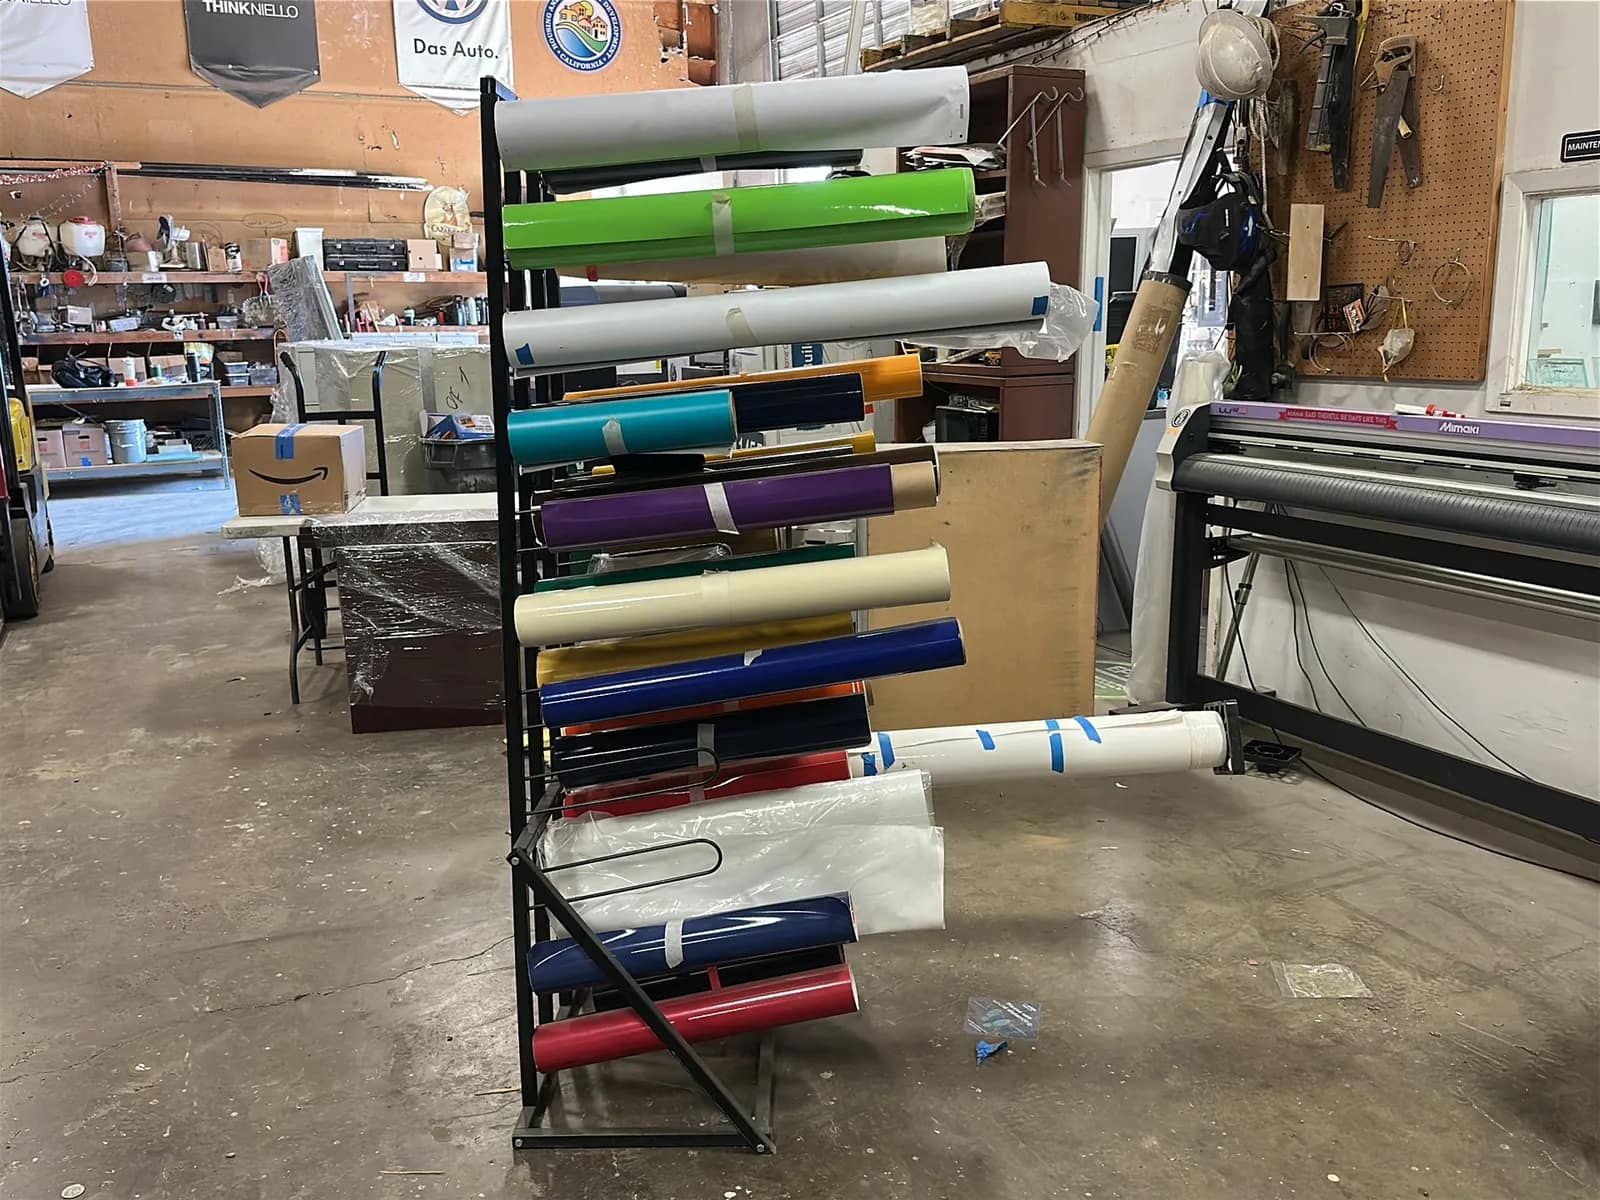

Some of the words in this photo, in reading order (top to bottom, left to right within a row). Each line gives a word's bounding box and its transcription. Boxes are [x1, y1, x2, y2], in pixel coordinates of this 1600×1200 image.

[413, 38, 447, 56] Das
[452, 41, 498, 59] Auto.
[560, 54, 604, 69] CALIFORNIA
[1439, 421, 1480, 434] Mimaki
